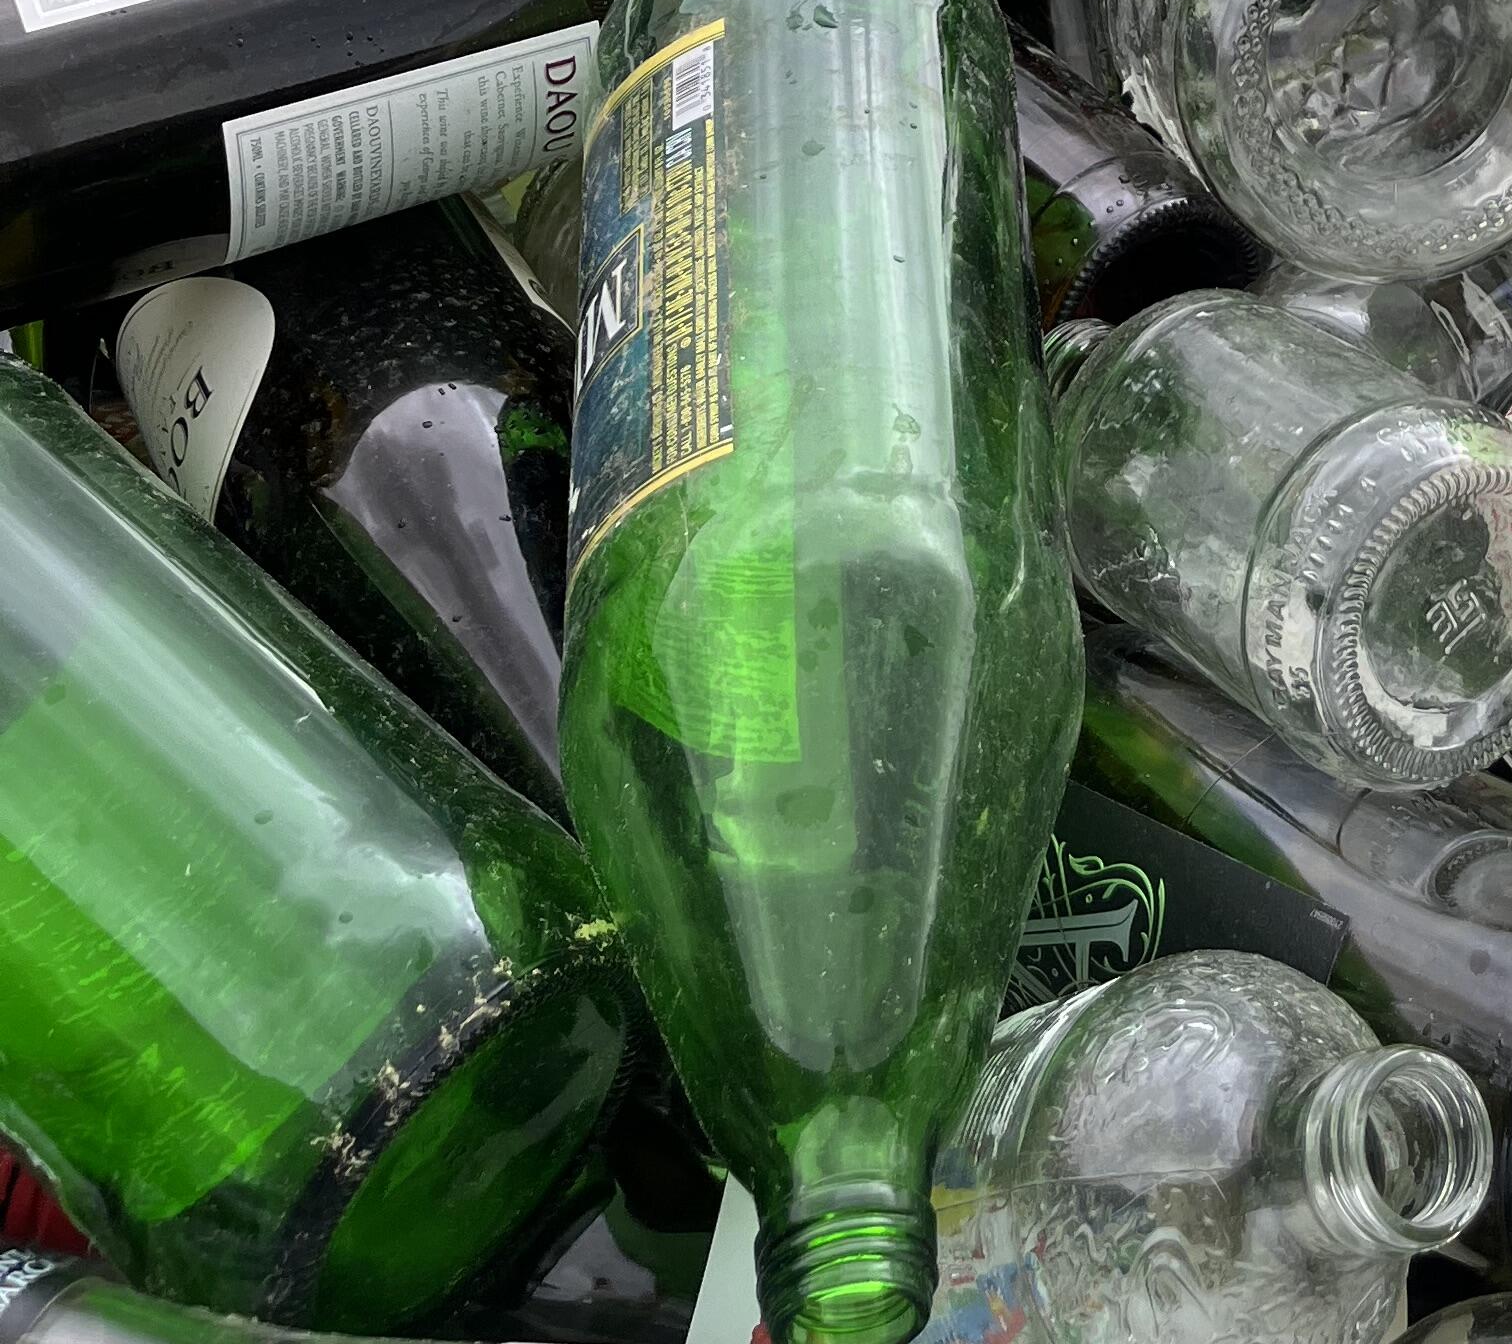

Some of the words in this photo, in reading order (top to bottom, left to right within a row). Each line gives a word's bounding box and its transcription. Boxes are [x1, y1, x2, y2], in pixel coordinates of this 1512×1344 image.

[436, 87, 448, 113] This
[477, 75, 487, 97] this
[493, 69, 505, 118] Cabernet
[510, 64, 522, 123] Experience
[417, 92, 430, 147] experiences
[477, 99, 486, 124] wine
[543, 55, 578, 153] DAOU
[303, 122, 315, 163] PREGNANCY
[331, 114, 345, 166] GOVERNMENT
[348, 110, 360, 148] CELLARED
[436, 113, 445, 138] wine
[462, 129, 472, 148] that
[249, 137, 260, 161] 750ML
[289, 126, 300, 163] ALCOHOLIC
[352, 149, 360, 164] AND
[253, 172, 264, 204] CONTAINS
[278, 174, 286, 188] AND
[666, 343, 677, 393] QUESTIONS
[665, 393, 675, 446] CONSUMER
[666, 444, 676, 463] FOR
[680, 431, 691, 457] CALL
[1265, 570, 1292, 709] CAYMAN
